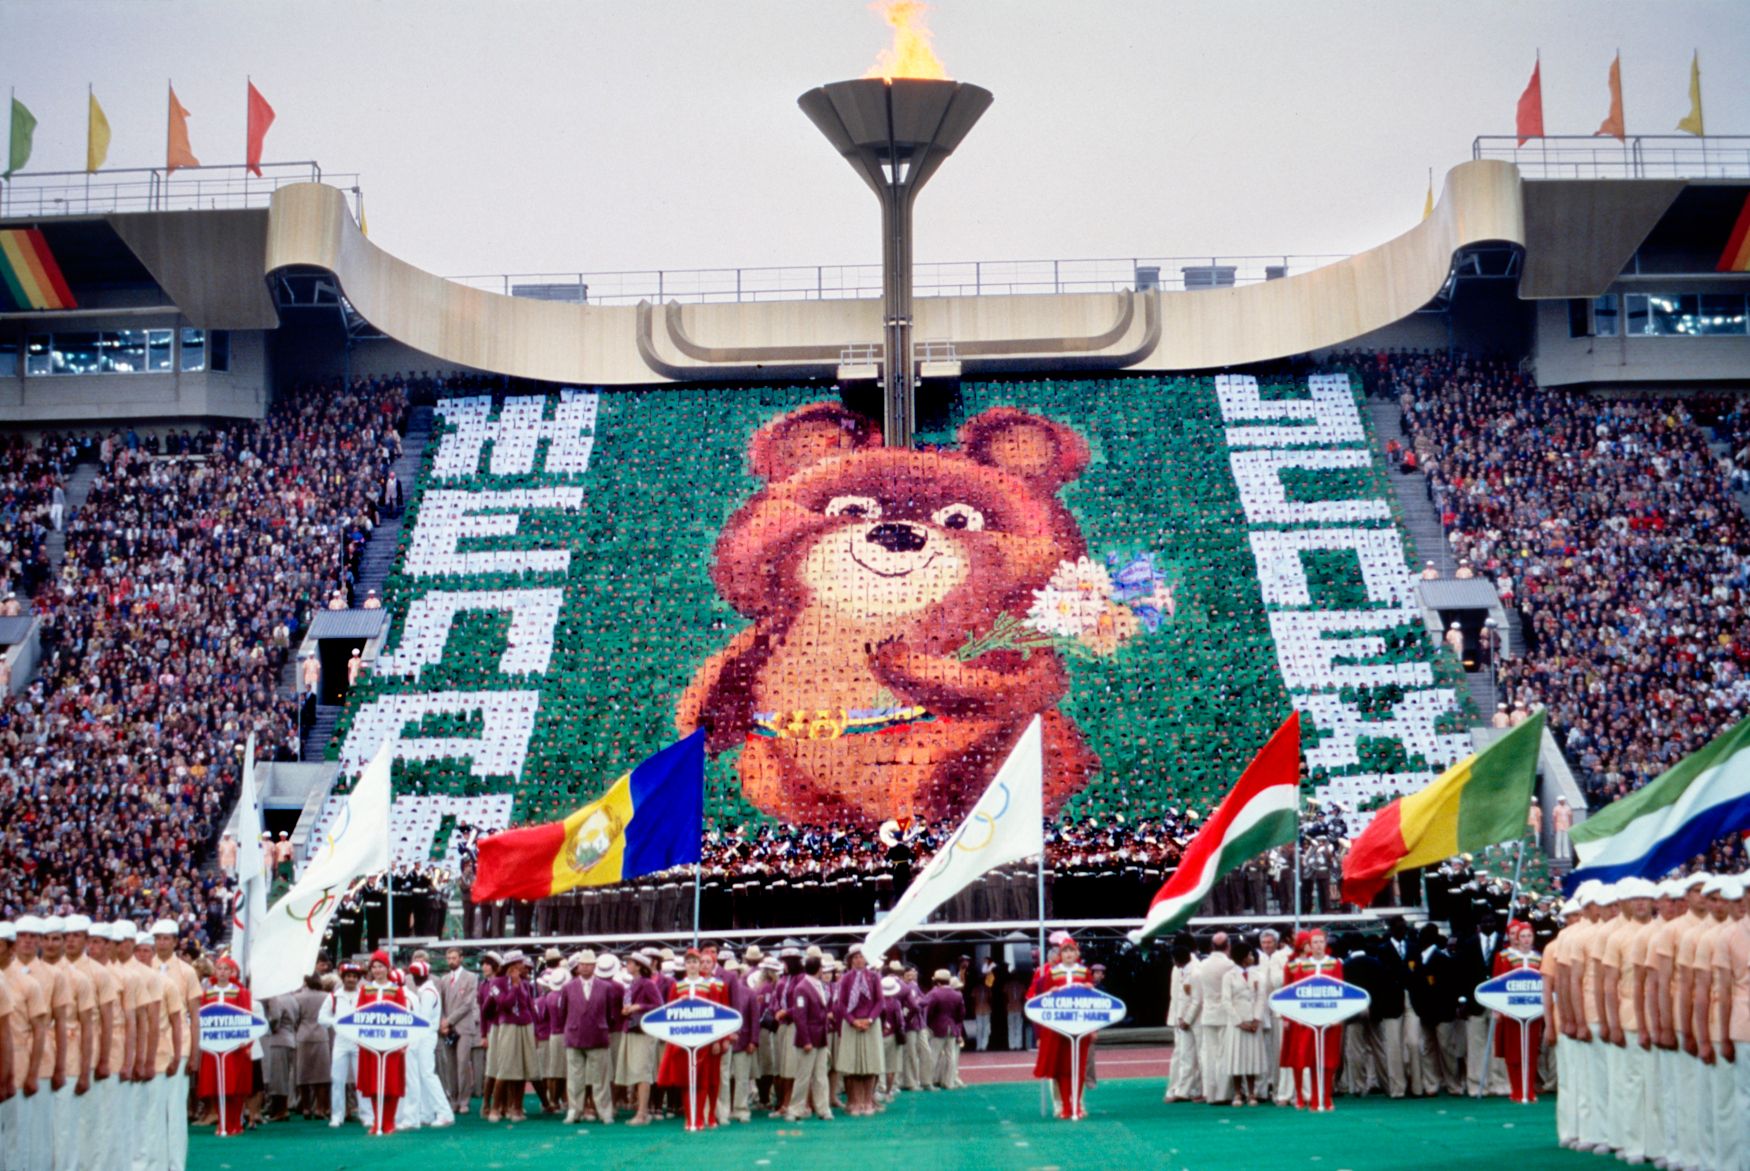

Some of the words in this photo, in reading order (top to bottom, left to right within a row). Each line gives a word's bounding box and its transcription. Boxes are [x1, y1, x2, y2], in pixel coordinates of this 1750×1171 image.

[1296, 984, 1343, 998] СЕЙШЕЛЫ
[353, 1012, 414, 1025] ПУЭРТО-РИКО
[666, 1006, 714, 1021] РУМЫНИЯ
[359, 1028, 385, 1038] PORTO
[390, 1029, 408, 1039] RICO
[670, 1024, 713, 1035] ROUMANIE
